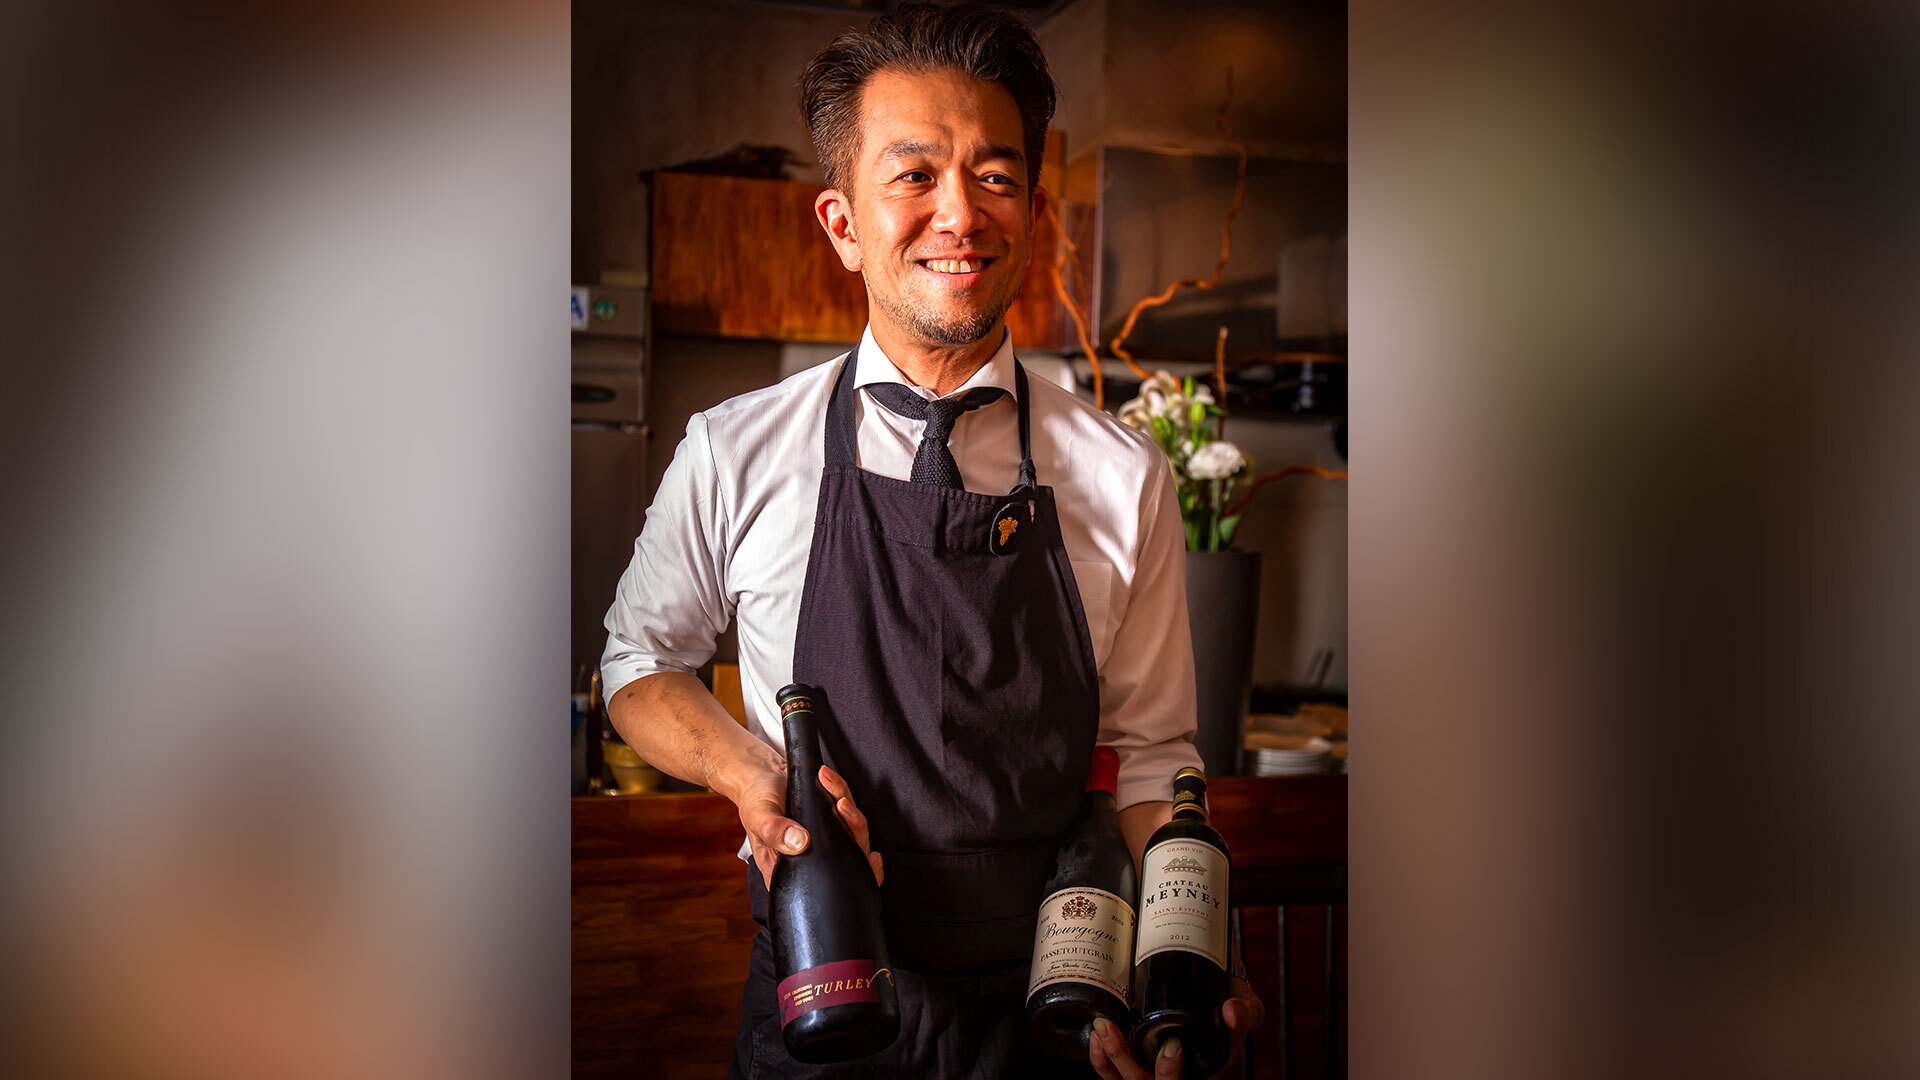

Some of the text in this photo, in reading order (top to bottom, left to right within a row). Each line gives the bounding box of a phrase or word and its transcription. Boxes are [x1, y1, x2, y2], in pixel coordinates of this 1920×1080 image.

[571, 294, 584, 320] A
[1158, 880, 1209, 890] CHATEAU
[1145, 888, 1221, 910] MEYNEY
[1043, 922, 1120, 944] Bourgogne
[1040, 947, 1114, 963] PASSETOUTGRAIN
[814, 978, 873, 996] TURLEY
